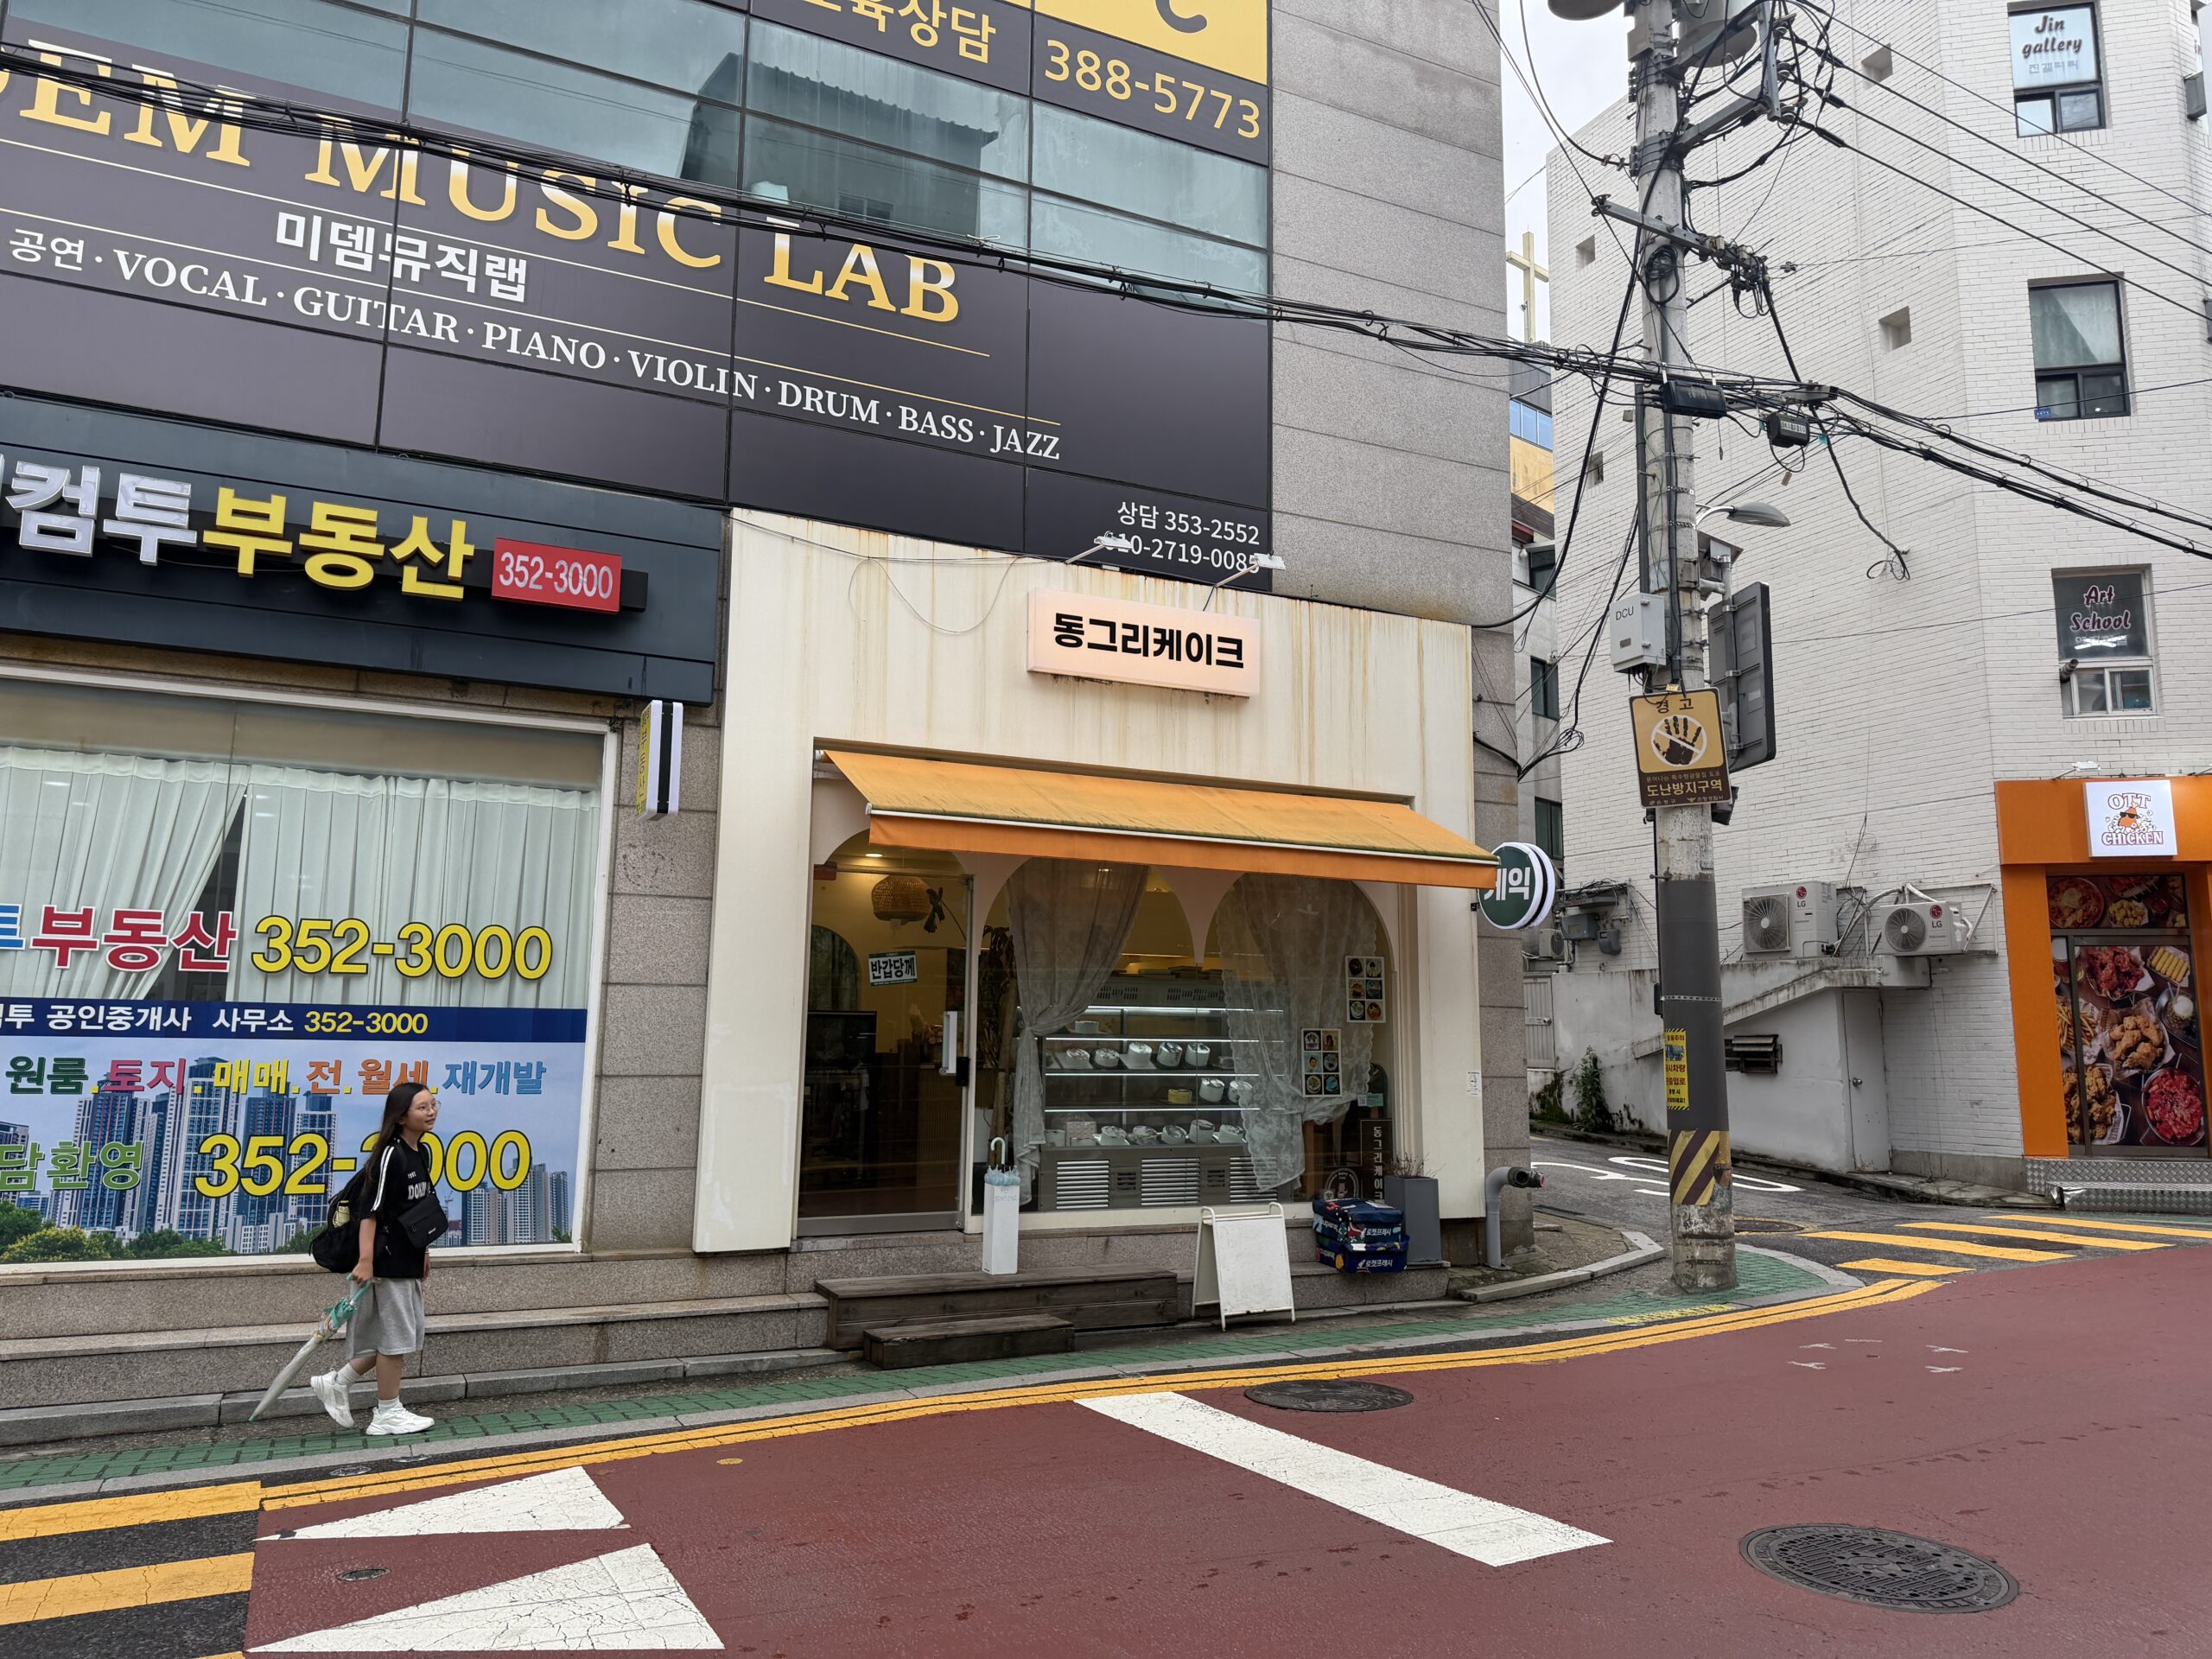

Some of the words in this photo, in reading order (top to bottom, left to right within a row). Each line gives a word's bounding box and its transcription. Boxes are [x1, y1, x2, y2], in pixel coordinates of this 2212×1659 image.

[2035, 15, 2065, 34] Jin
[2022, 39, 2082, 59] gallery
[804, 0, 996, 63] 육상담
[1045, 40, 1260, 138] 388-5773
[0, 39, 256, 167] EM
[305, 114, 722, 268] MUSIC
[763, 216, 960, 323] LAB
[276, 212, 528, 303] 미뎀뮤직랩
[10, 228, 85, 270] 공연
[113, 249, 267, 306] VOCAL
[293, 287, 459, 343] GUITAR
[482, 322, 605, 370] PIANO
[627, 350, 759, 400] VIOLIN
[778, 380, 880, 424] DRUM
[898, 406, 975, 442] BASS
[989, 424, 1061, 461] JAZZ
[1117, 501, 1159, 529] 상담
[1165, 511, 1260, 544] 353-2552
[499, 551, 614, 600] 352-3000
[2083, 585, 2115, 607] Art
[1615, 606, 1634, 621] DCU
[2069, 609, 2131, 632] School
[1053, 612, 1244, 669] 동그리케이크
[1647, 779, 1723, 797] 도난방지구역
[2107, 792, 2152, 810] OTT
[2101, 831, 2164, 846] CHICKEN
[251, 914, 552, 980] 352-3000
[871, 957, 916, 980] 반갑당께
[0, 1003, 35, 1029] 투
[47, 1004, 192, 1032] 공인중개사
[213, 1007, 294, 1033] 사무소
[304, 1010, 429, 1034] 352-3000
[5, 1056, 89, 1094] 원룸
[102, 1058, 186, 1095] 토지
[213, 1058, 289, 1095] 매매
[306, 1059, 342, 1095] 전
[358, 1058, 429, 1096] 월세
[442, 1060, 546, 1096] 재개발
[194, 1129, 531, 1198] 352-00
[1365, 1259, 1393, 1268] 로켓프레시
